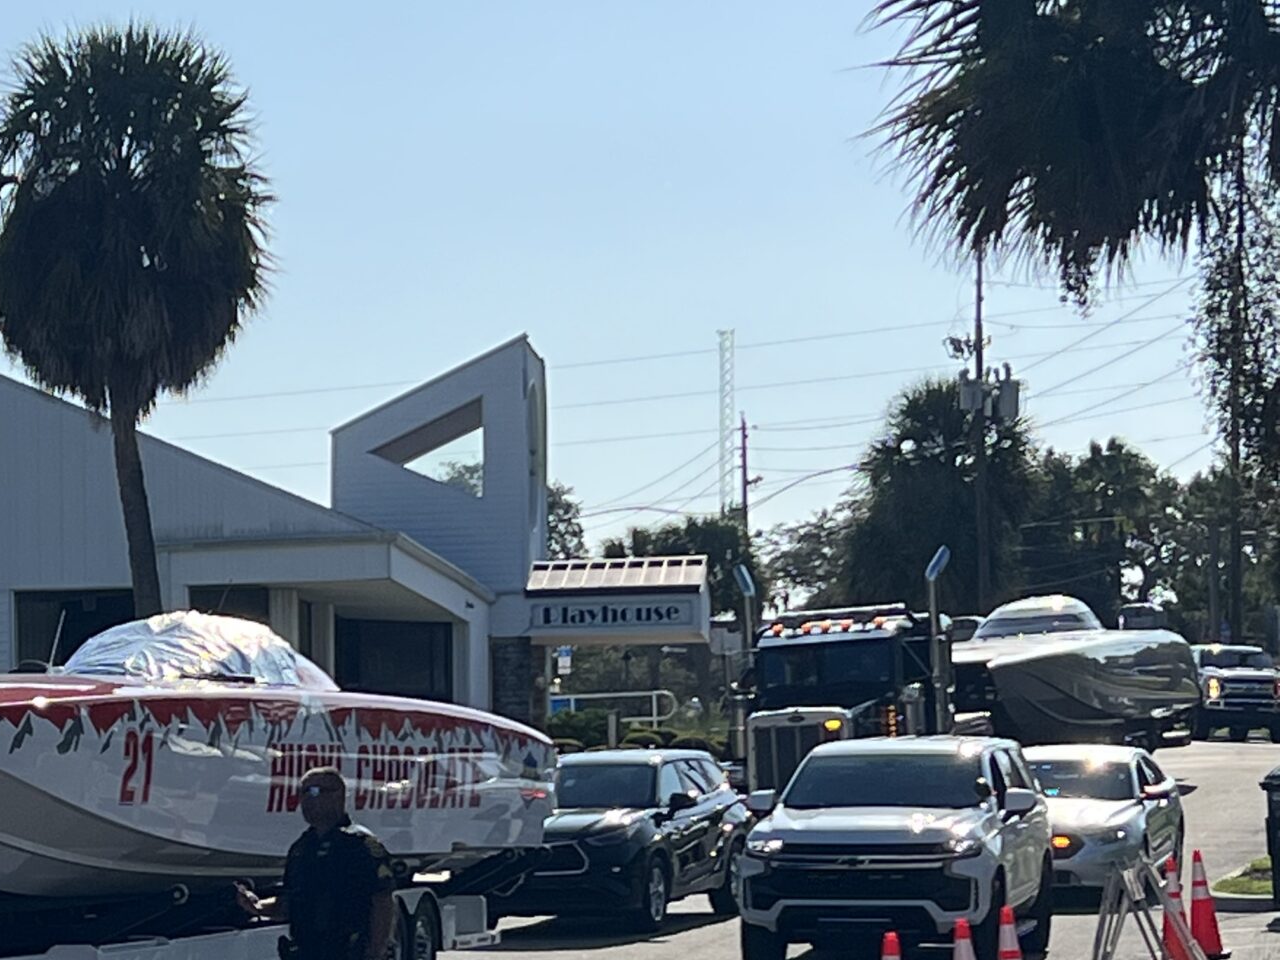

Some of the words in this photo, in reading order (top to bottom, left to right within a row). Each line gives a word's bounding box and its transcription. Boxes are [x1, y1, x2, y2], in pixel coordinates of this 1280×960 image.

[542, 605, 680, 625] Playhouse
[118, 728, 154, 806] 21
[355, 744, 483, 810] CHOCOLATE
